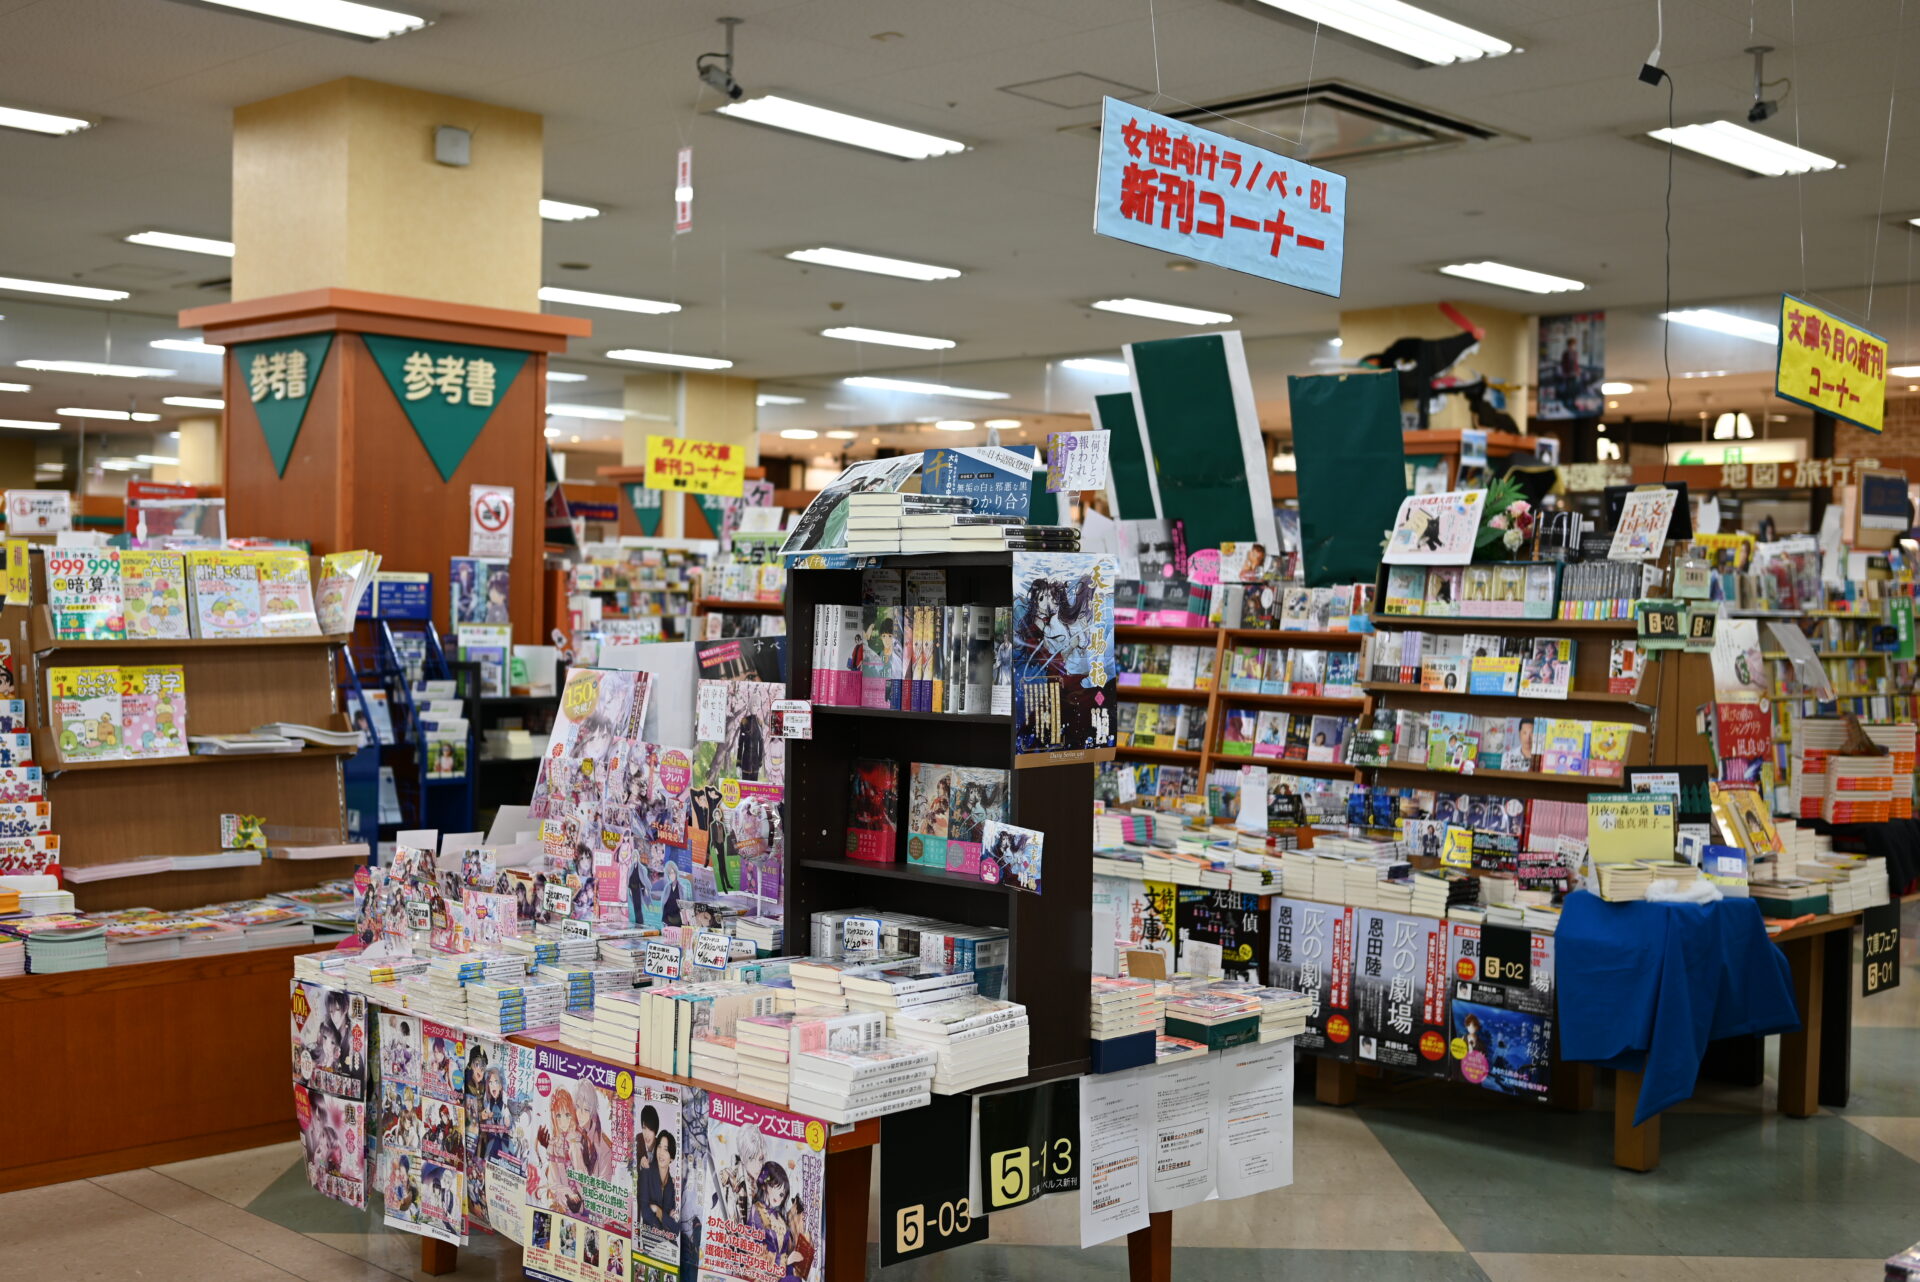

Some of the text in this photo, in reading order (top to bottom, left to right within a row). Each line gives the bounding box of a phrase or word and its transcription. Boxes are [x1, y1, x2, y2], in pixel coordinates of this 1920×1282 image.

[1121, 117, 1332, 214] 女性向けラノベ・BL
[1119, 162, 1325, 258] 新刊コーナー
[1788, 309, 1884, 381] 文庫今月の新刊
[250, 350, 308, 403] 参考書
[403, 351, 497, 407] 参考書
[1809, 367, 1861, 409] コーナー
[662, 439, 732, 461] ラノベ文庫
[1087, 439, 1101, 487] 何ひとつ
[653, 457, 737, 479] 新刊コーナー
[149, 558, 181, 568] ABC
[9, 577, 27, 593] 5-04
[77, 674, 117, 685] たしざん
[1423, 663, 1457, 672] 沖縄文化論
[77, 685, 117, 697] ひきざん
[143, 674, 182, 695] 漢字
[1730, 721, 1761, 735] シャングリラ
[1737, 737, 1771, 756] 凪良ゆう
[1590, 804, 1650, 817] 月夜の森の梟
[1601, 818, 1661, 830] 小池真理子
[1142, 885, 1162, 950] 文庫
[1160, 888, 1175, 943] 待望の
[845, 938, 861, 949] 4/20
[1277, 905, 1293, 964] 恩田陸
[1364, 917, 1384, 977] 恩田陸
[1866, 928, 1898, 958] 文庫フェア
[647, 951, 679, 963] クロスノベルス
[647, 959, 678, 977] 2/10 新刊
[1299, 907, 1326, 1019] 灰の劇場
[1487, 958, 1524, 980] 5-02
[1387, 920, 1419, 1035] 灰の劇場
[1531, 969, 1550, 993] 場
[1868, 961, 1893, 988] 5-01
[507, 1045, 519, 1100] 悪役令嬢
[538, 1050, 617, 1087] 角川ビーンズ文庫
[620, 1077, 627, 1092] 4
[712, 1098, 805, 1139] 角川ビーンズ文庫
[812, 1128, 819, 1144] 3
[1000, 1137, 1072, 1200] 5-13
[567, 1168, 629, 1198] 妹に婚約者を取られたら
[582, 1187, 629, 1211] 見知らぬ公爵様に
[584, 1200, 629, 1222] 求婚されました2
[707, 1215, 766, 1240] わたくしのことが
[902, 1197, 971, 1247] 5-03
[706, 1230, 765, 1256] 大嫌いな義弟が
[705, 1244, 786, 1277] 護衛騎士になりました3
